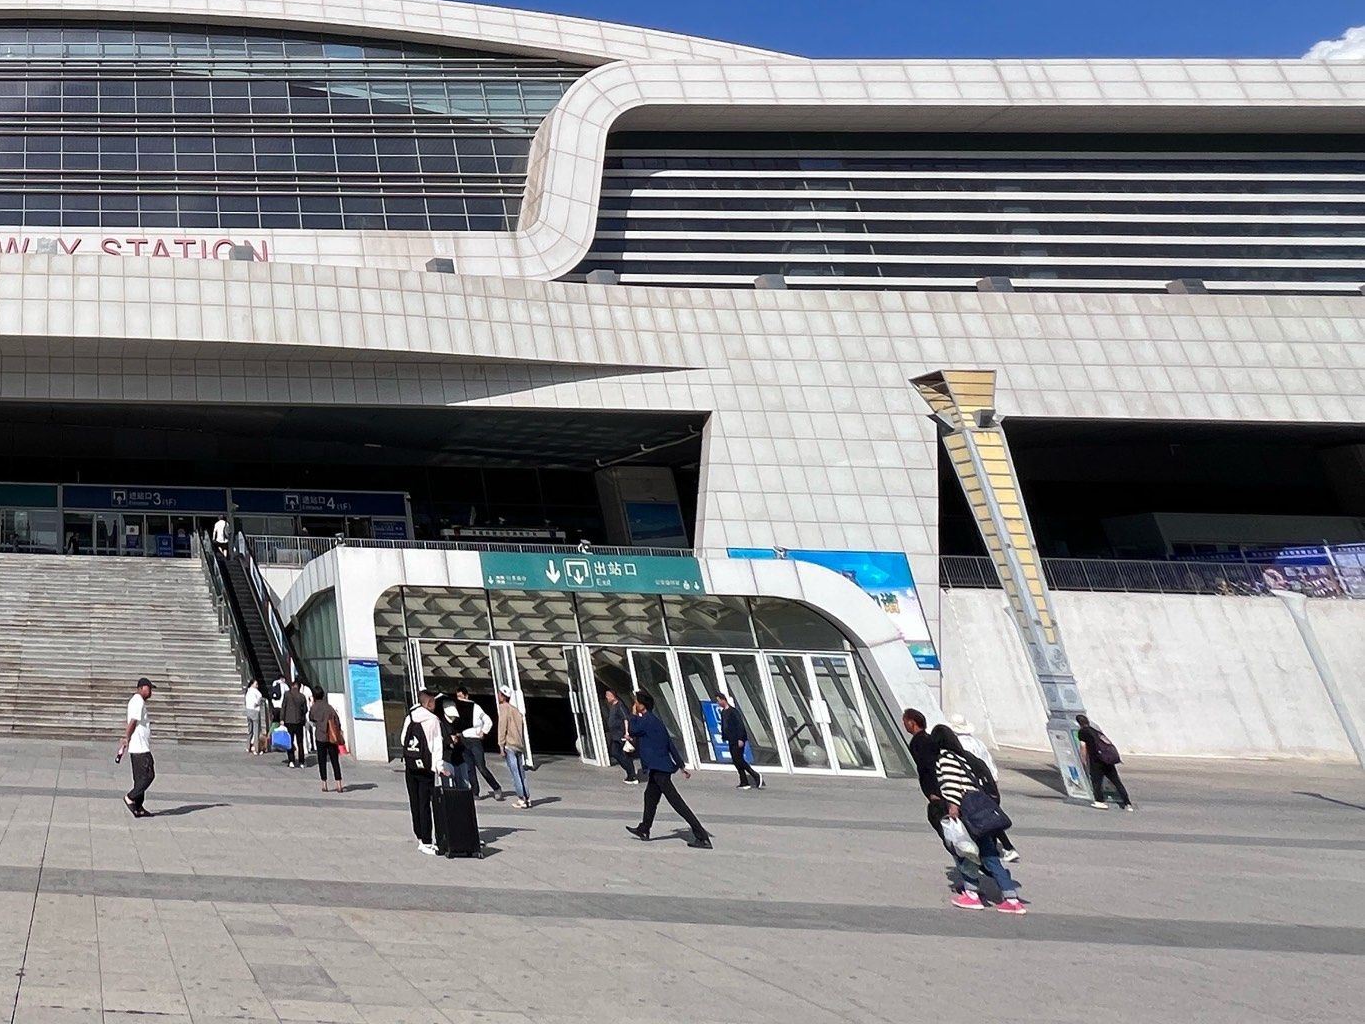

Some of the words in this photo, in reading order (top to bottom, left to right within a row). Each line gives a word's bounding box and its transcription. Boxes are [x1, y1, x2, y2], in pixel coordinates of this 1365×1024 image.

[593, 560, 637, 577] 出站口
[596, 577, 612, 587] Exit
